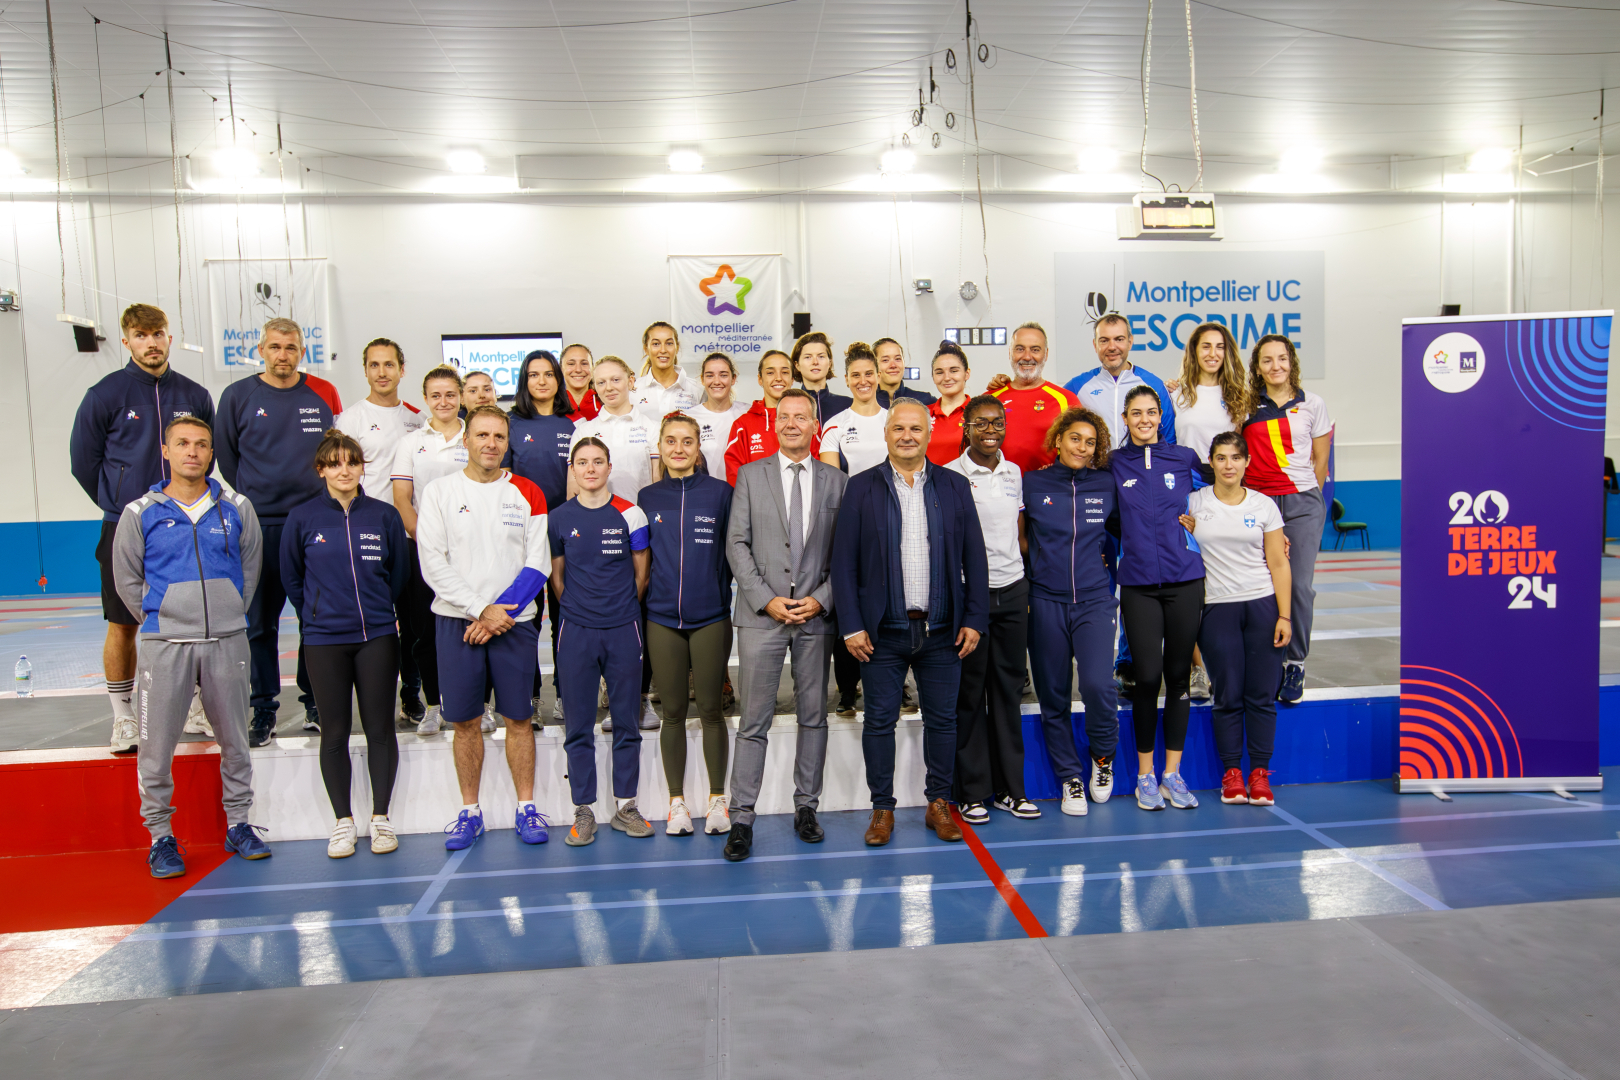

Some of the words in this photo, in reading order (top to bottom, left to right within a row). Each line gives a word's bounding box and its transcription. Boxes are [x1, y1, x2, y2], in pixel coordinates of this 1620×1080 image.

[1126, 280, 1261, 308] Montpellier
[1266, 280, 1301, 302] UC
[469, 350, 527, 365] Montpelli
[1448, 525, 1537, 551] TERRE
[1448, 552, 1483, 576] DE
[1488, 550, 1557, 575] JEUX
[1507, 576, 1557, 609] 24
[141, 689, 149, 741] MONTPELLIER
